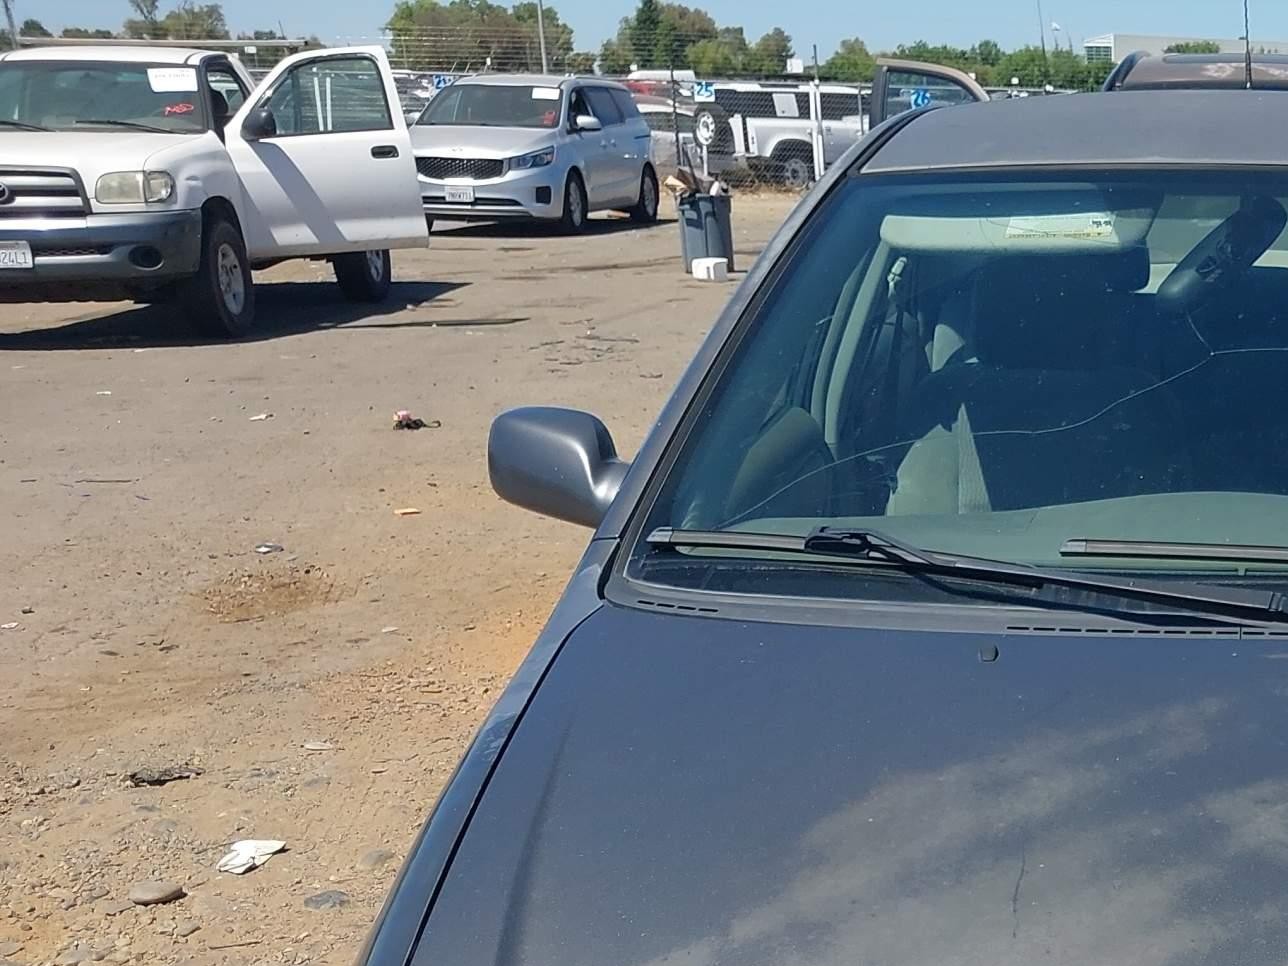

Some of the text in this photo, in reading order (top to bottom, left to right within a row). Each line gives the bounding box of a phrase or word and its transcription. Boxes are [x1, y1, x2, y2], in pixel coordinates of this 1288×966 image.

[696, 81, 713, 97] 25
[912, 89, 930, 106] 26
[0, 251, 29, 265] 24L1
